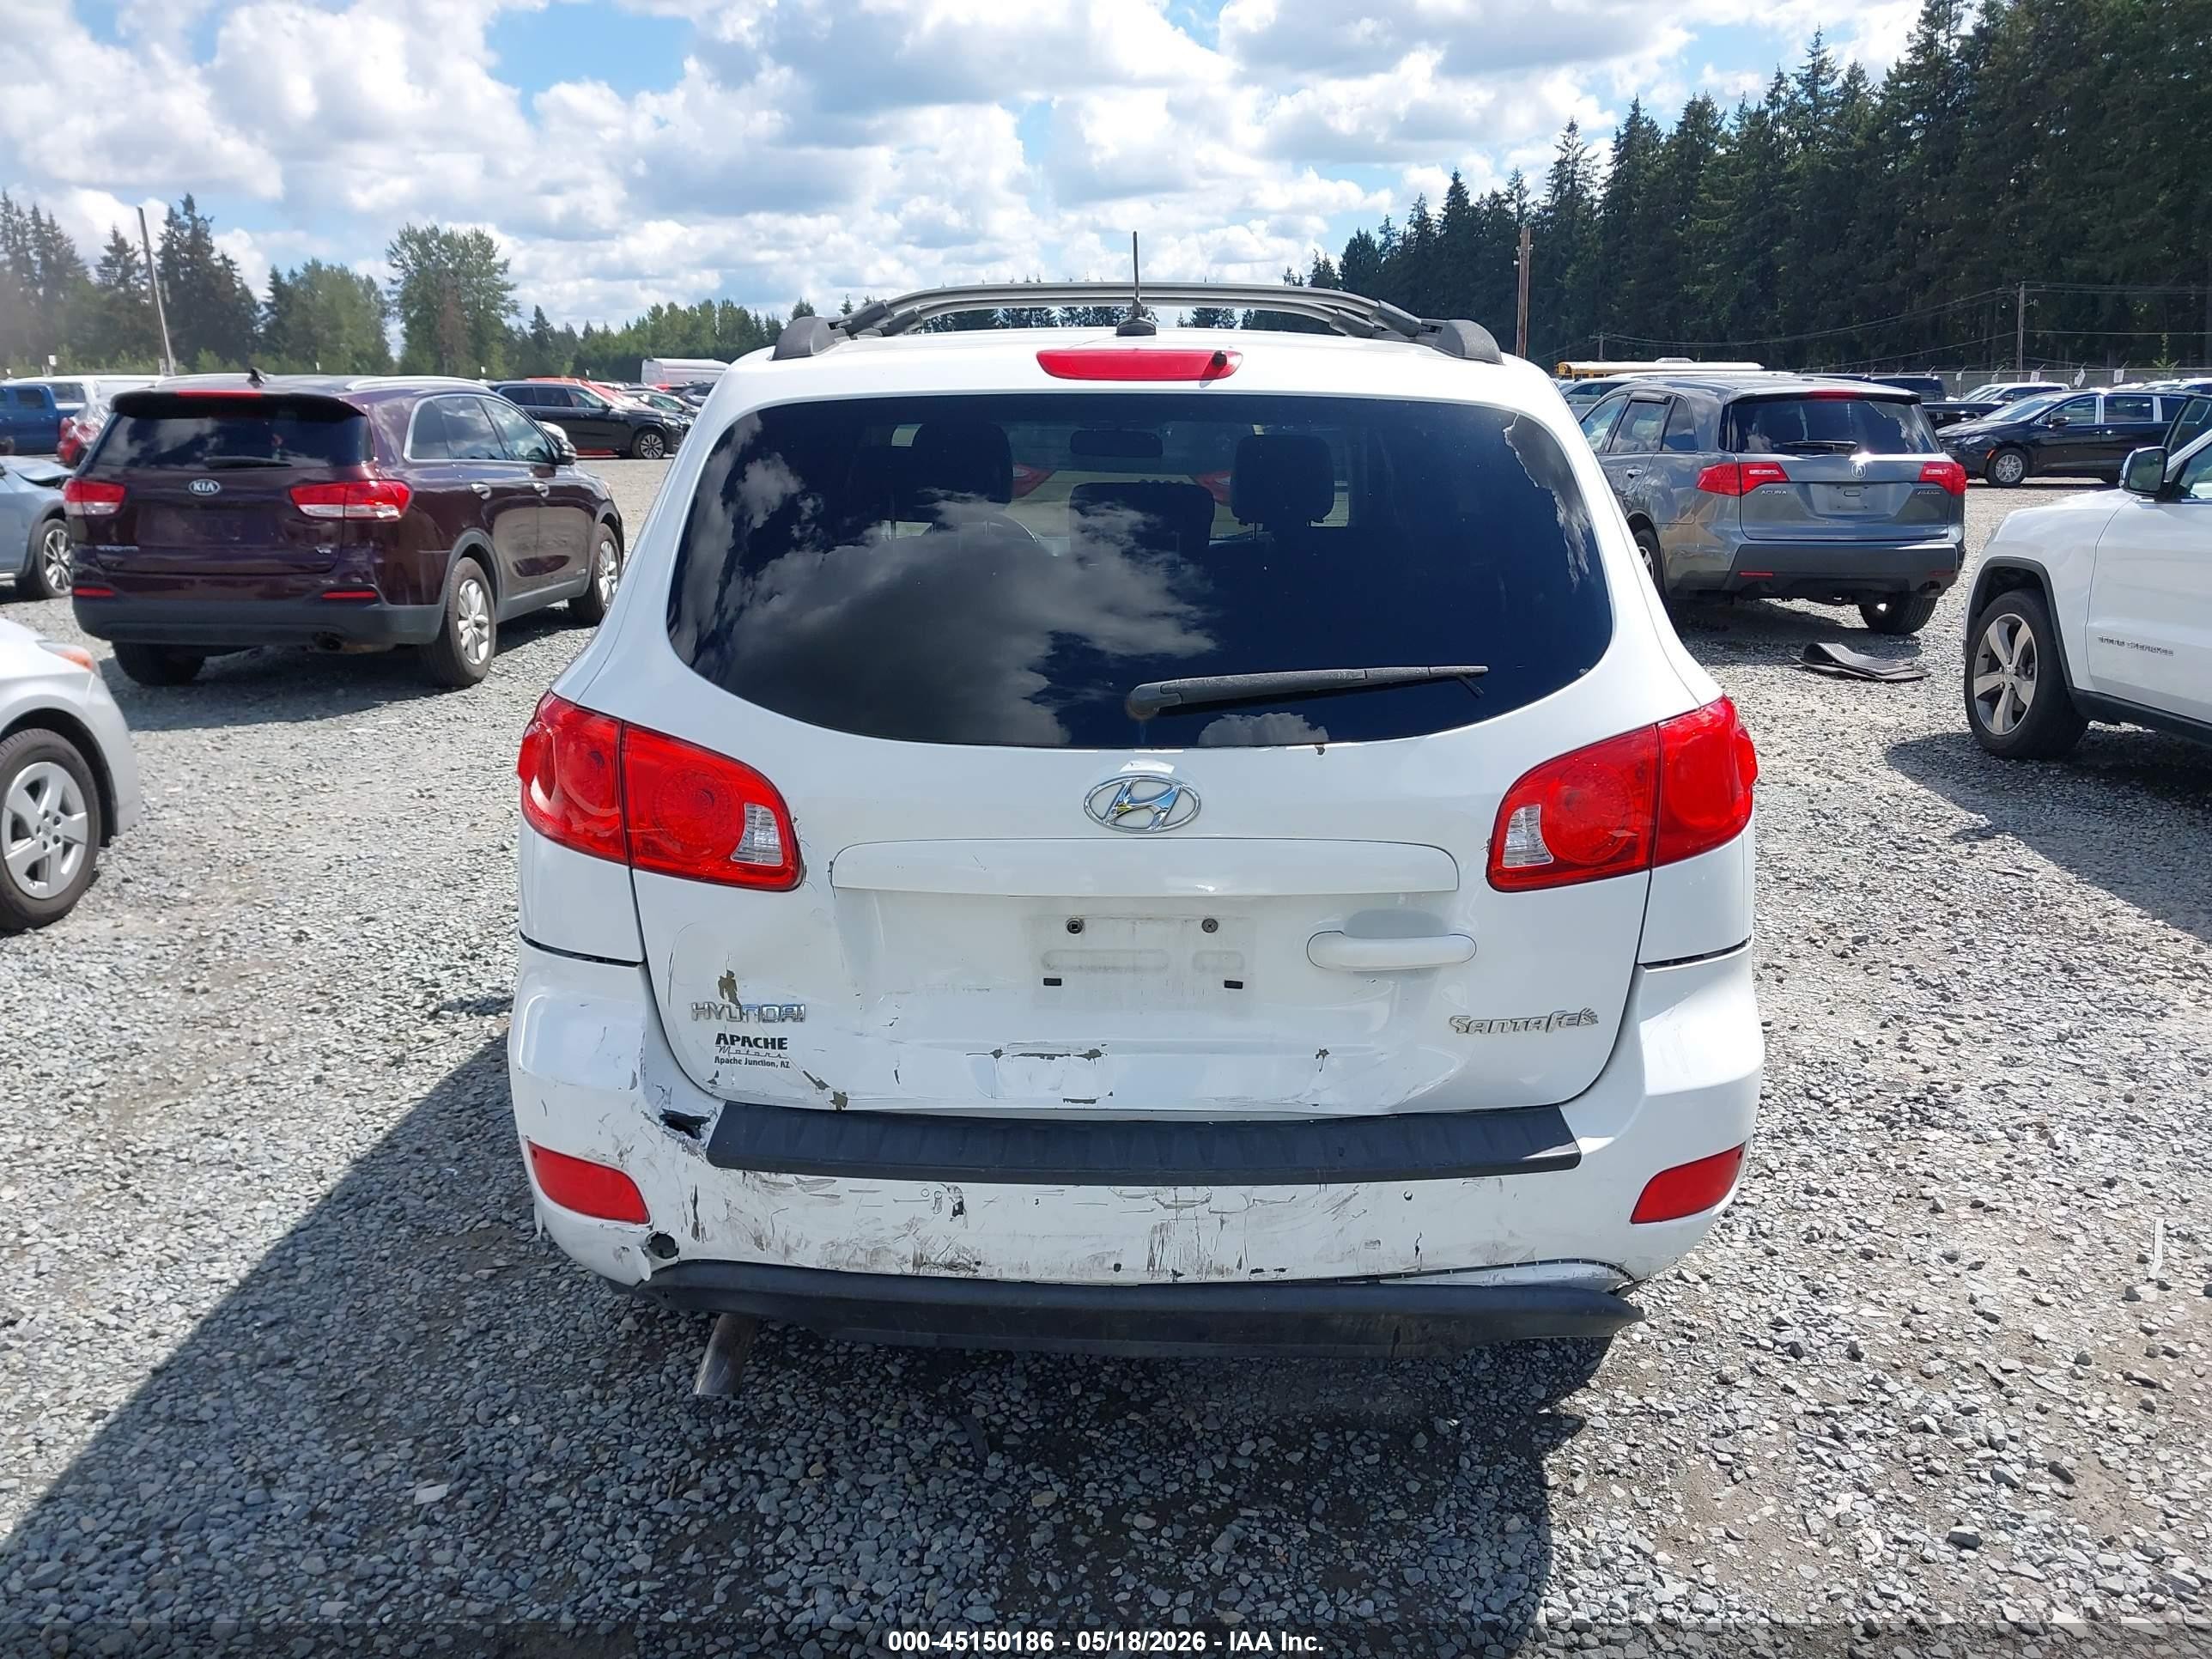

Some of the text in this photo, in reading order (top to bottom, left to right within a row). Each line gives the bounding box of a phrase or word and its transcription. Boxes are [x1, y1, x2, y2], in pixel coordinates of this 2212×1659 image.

[193, 481, 214, 491] KIA
[691, 1002, 805, 1023] HYUNDAI
[715, 1033, 788, 1050] APACHE
[715, 1045, 788, 1059] Motors
[714, 1056, 791, 1069] Apache Junction, AZ
